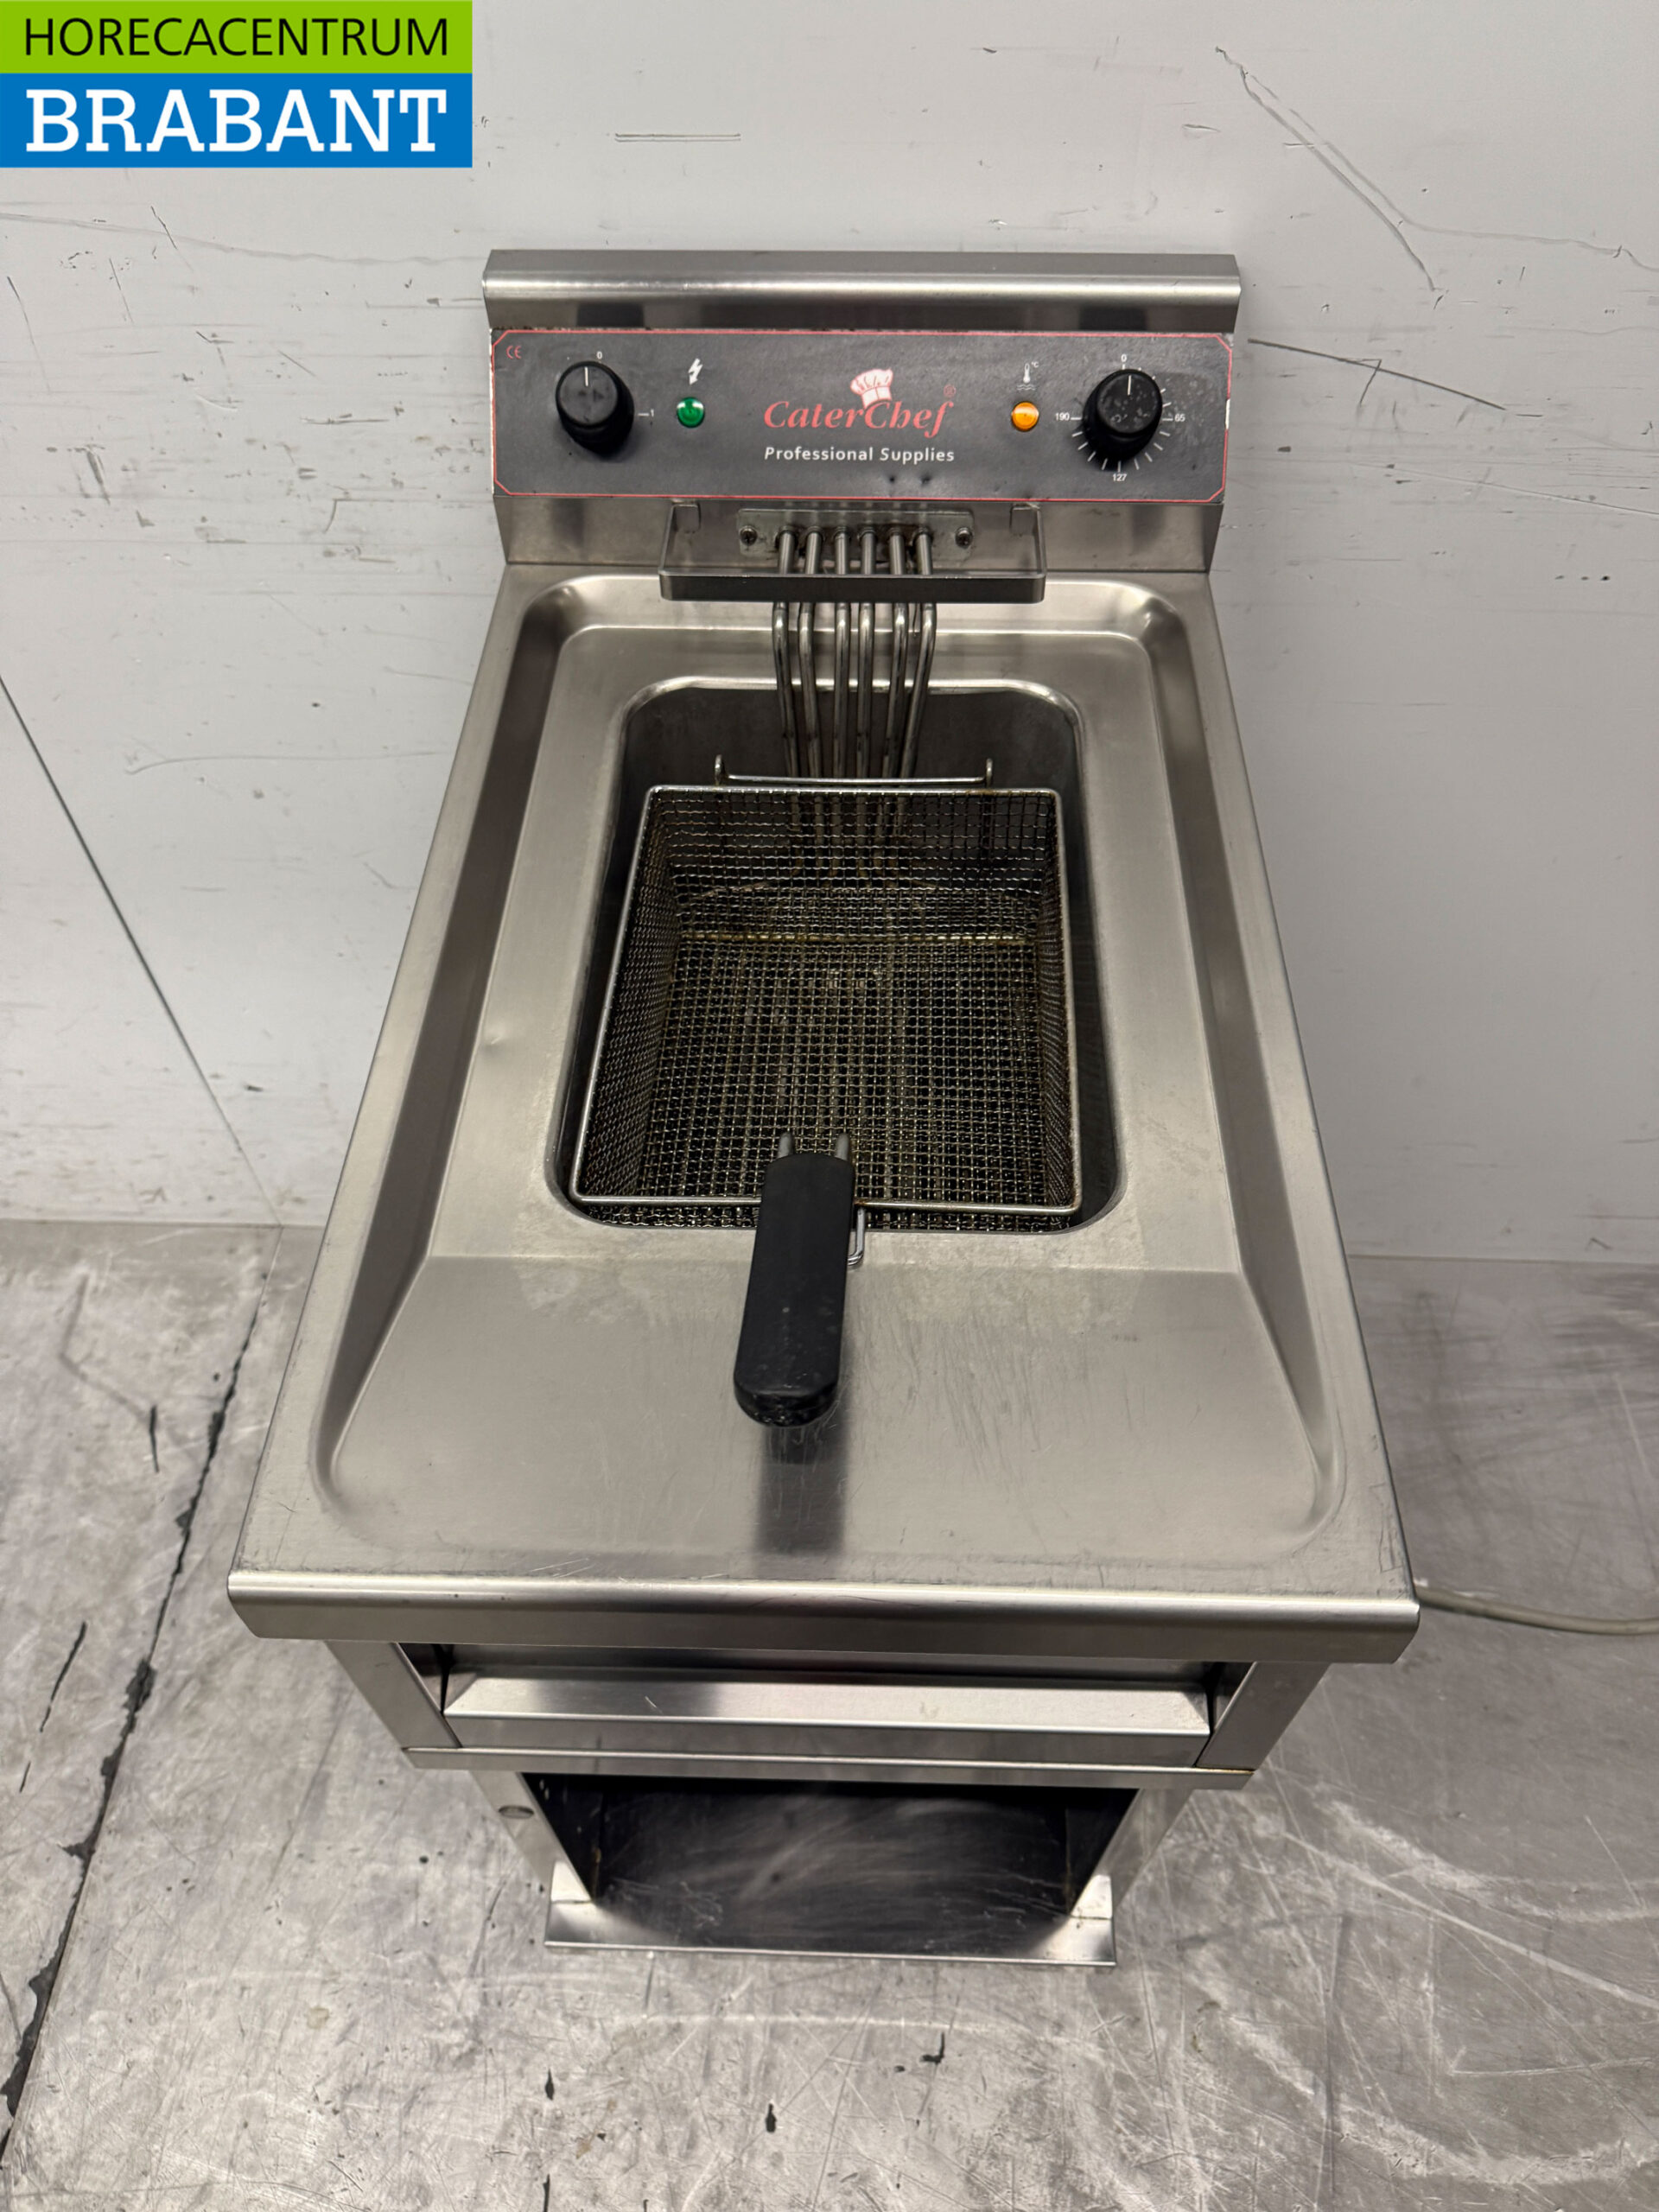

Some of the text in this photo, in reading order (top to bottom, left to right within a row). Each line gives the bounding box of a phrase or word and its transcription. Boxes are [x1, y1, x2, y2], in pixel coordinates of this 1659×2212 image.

[596, 351, 603, 360] 0
[1121, 353, 1128, 363] 0
[764, 400, 955, 439] CaterChef
[1055, 412, 1071, 422] 190
[1174, 413, 1185, 423] 65
[764, 446, 955, 465] Professional Supplies
[1112, 473, 1128, 482] 127
